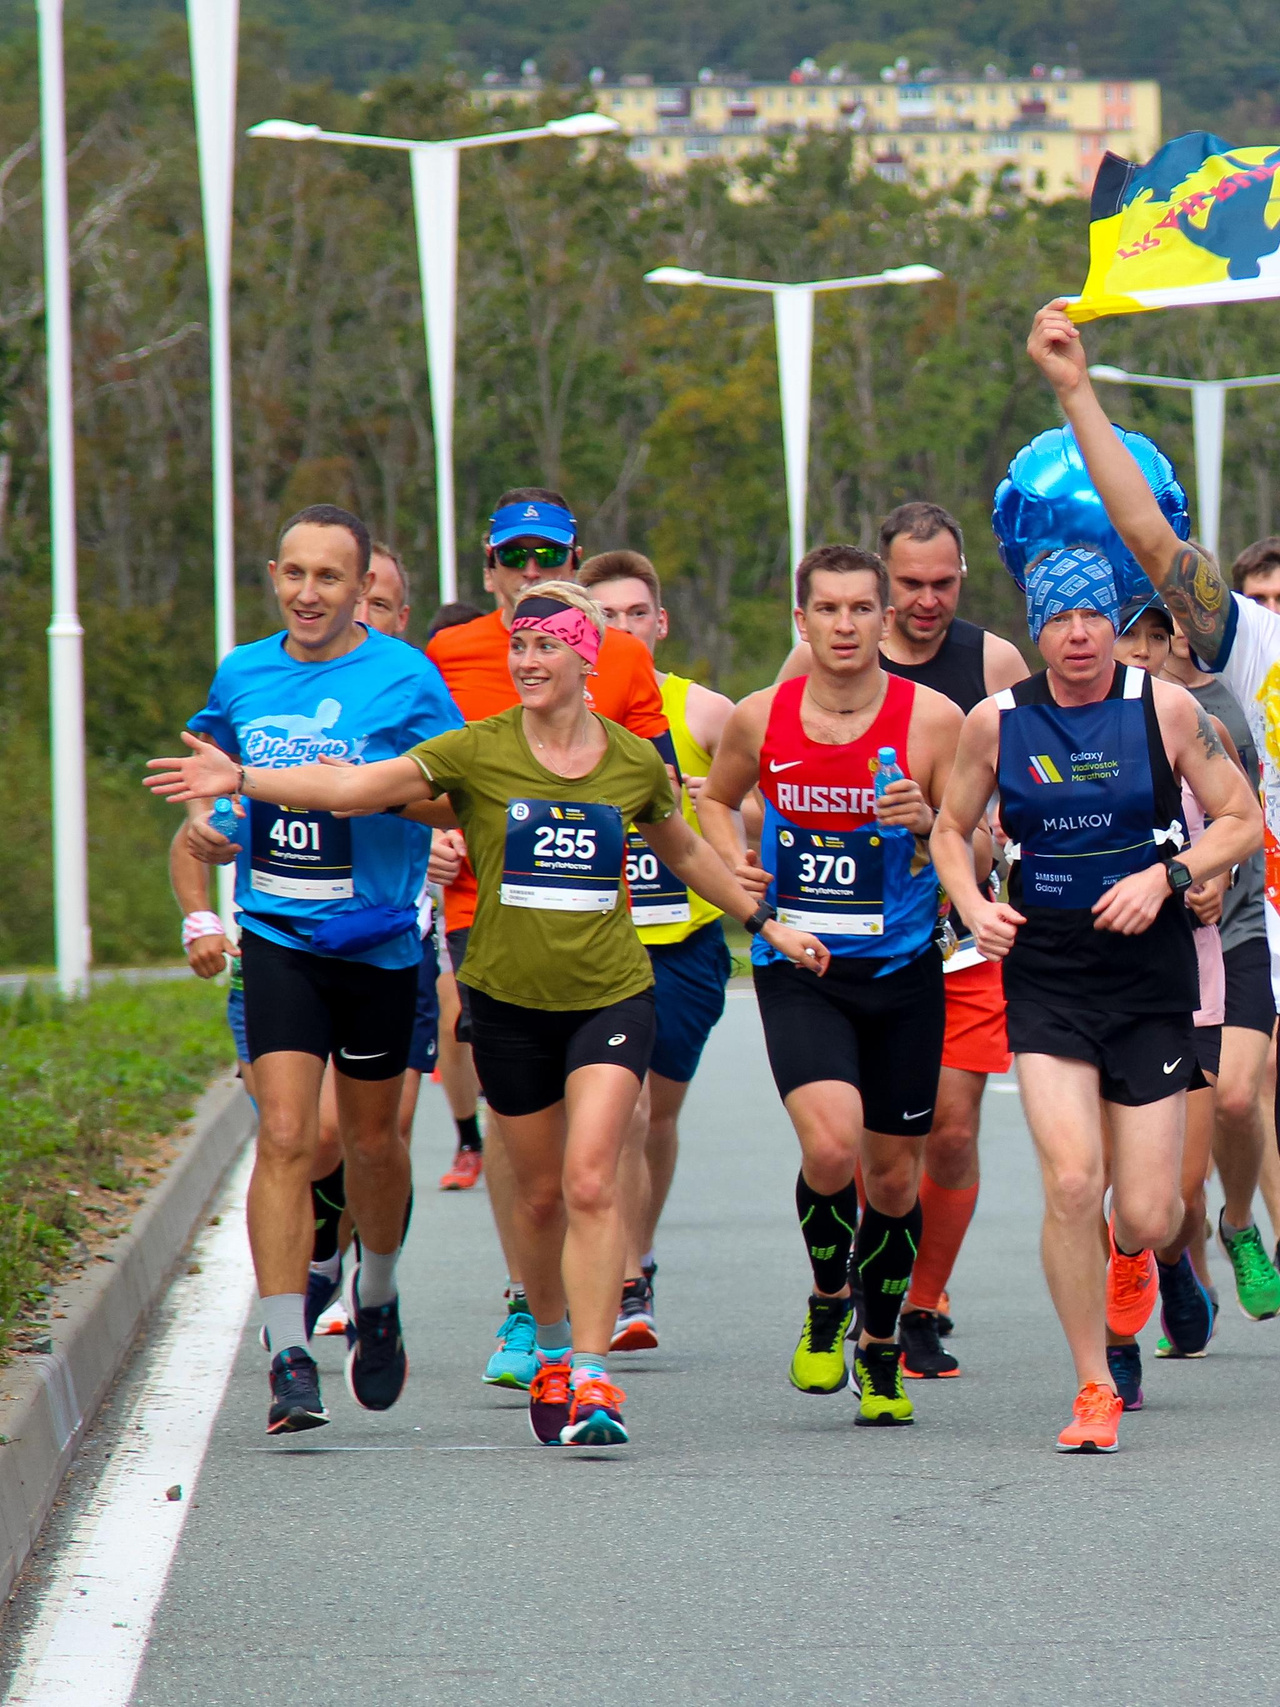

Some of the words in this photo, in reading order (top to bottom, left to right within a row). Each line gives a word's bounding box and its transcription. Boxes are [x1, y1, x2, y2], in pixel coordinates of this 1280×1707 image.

[1070, 751, 1104, 762] Galaxy
[1071, 760, 1119, 772] Vladivostok
[1071, 771, 1112, 782] Marathon
[1112, 769, 1120, 777] V
[777, 782, 877, 815] RUSSIA
[1043, 812, 1113, 832] MALKOV
[269, 818, 321, 851] 401
[533, 826, 597, 860] 255
[798, 852, 857, 886] 370
[1034, 872, 1073, 883] SAMSUNG
[1034, 882, 1064, 896] Galaxy
